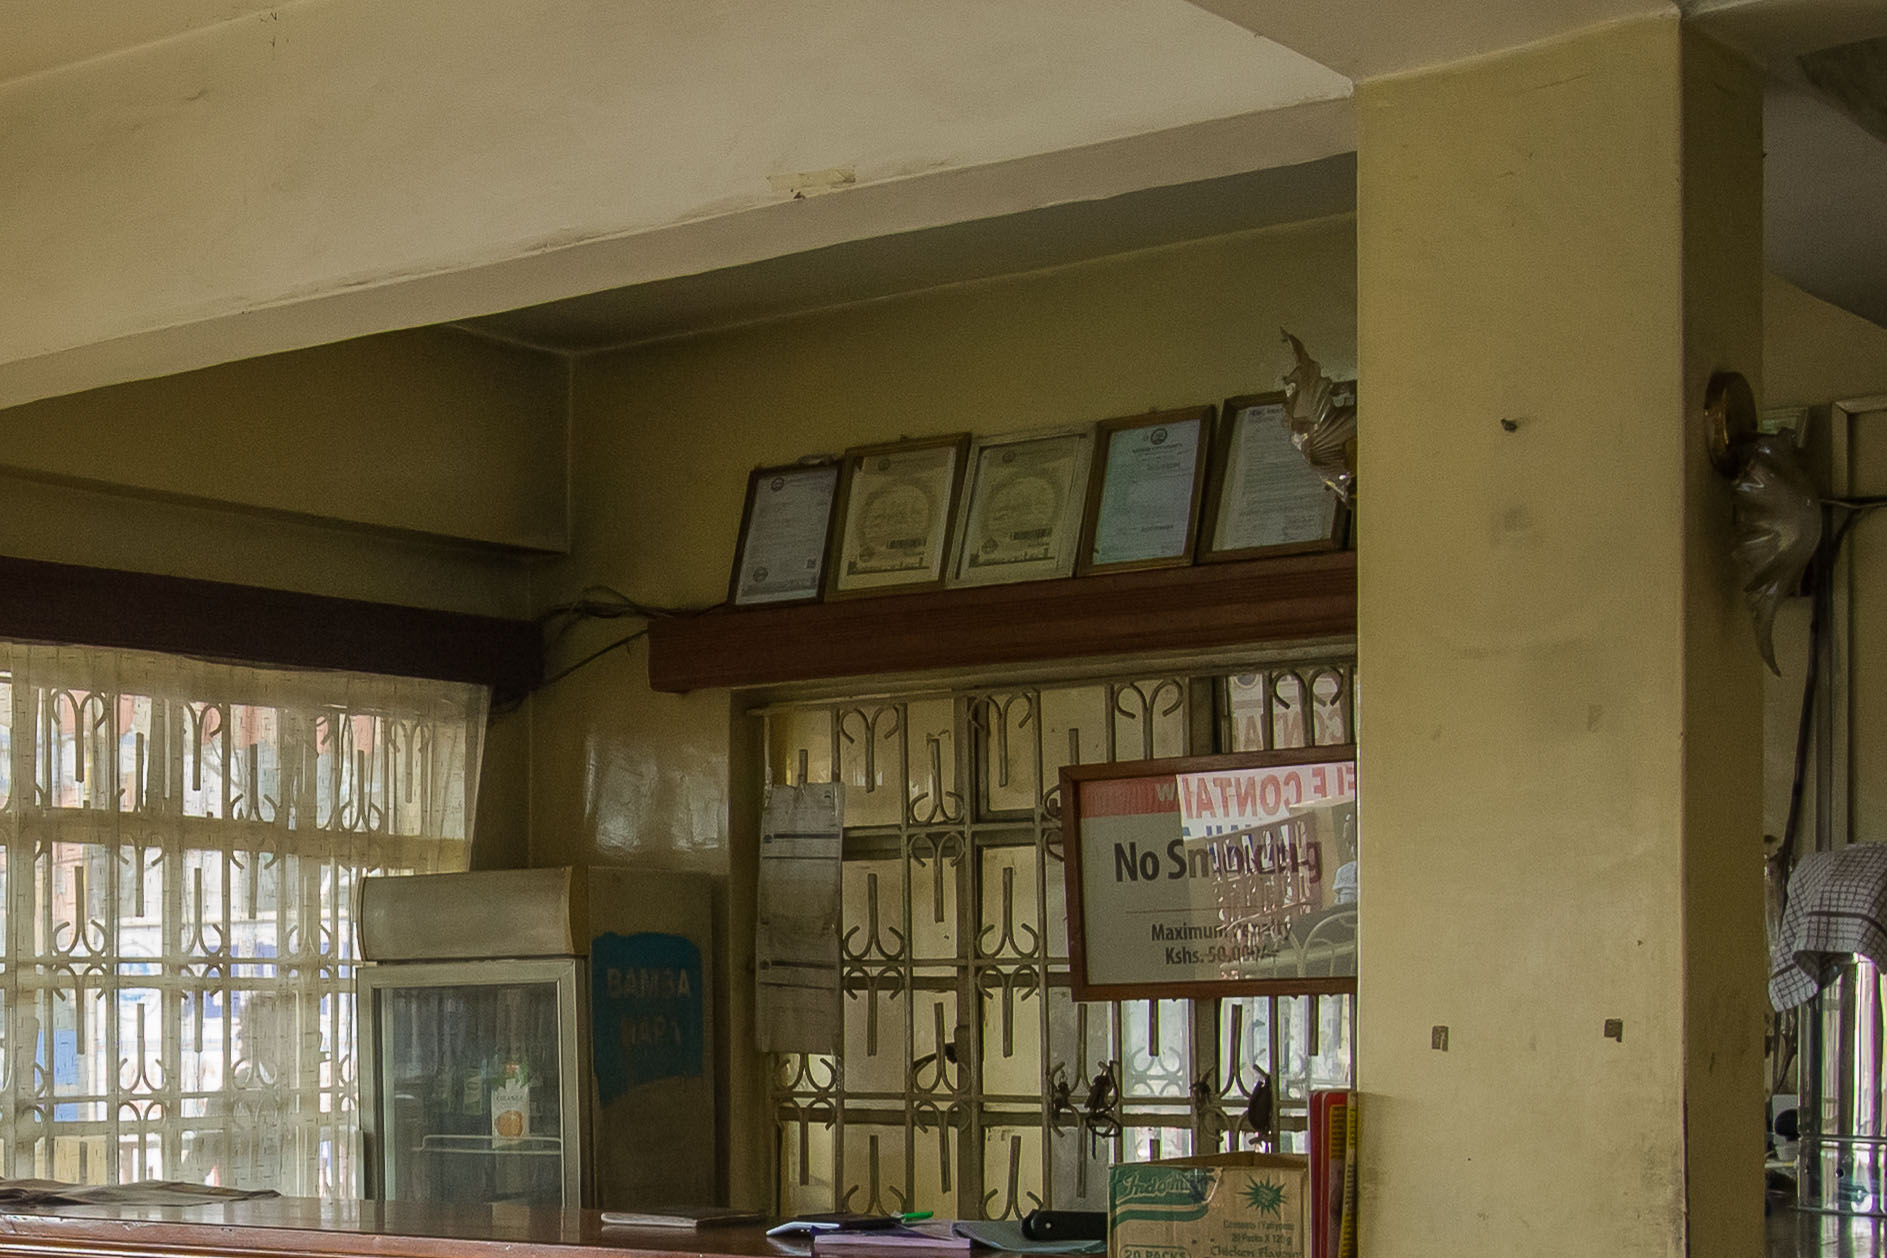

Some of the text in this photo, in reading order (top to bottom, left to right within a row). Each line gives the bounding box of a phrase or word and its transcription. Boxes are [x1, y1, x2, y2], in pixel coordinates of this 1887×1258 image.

[1114, 841, 1160, 882] No
[1151, 922, 1227, 942] Maximum
[1165, 946, 1204, 965] Kshs.
